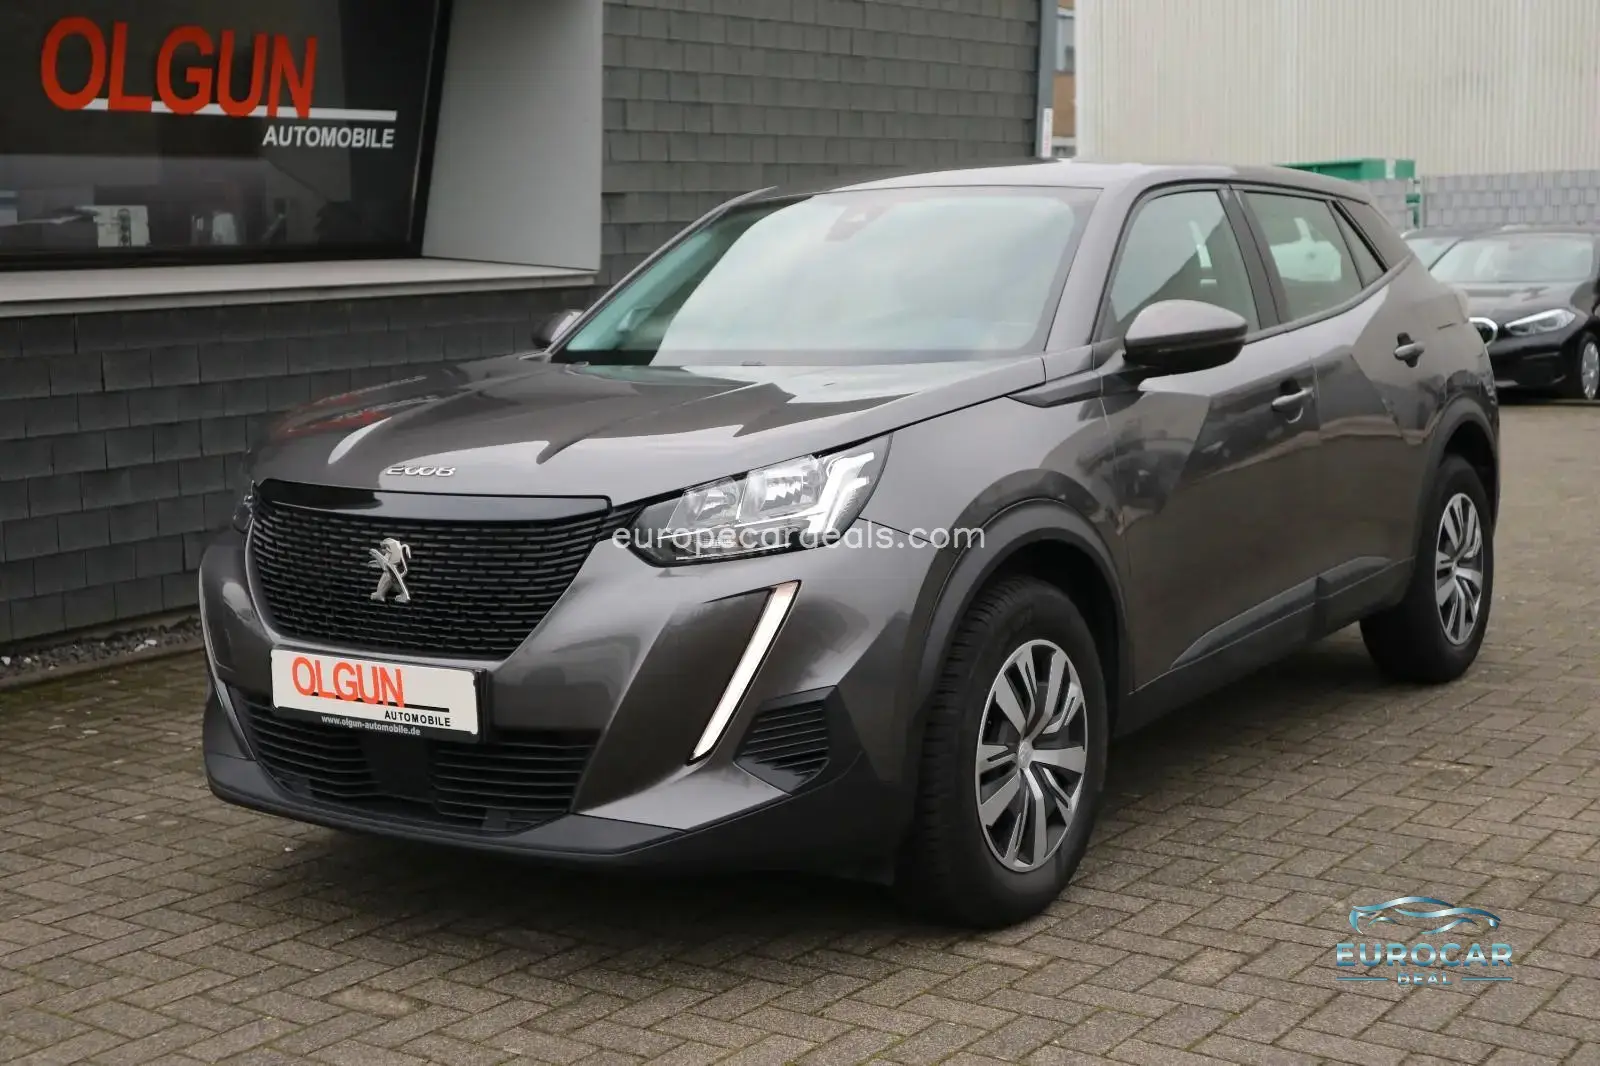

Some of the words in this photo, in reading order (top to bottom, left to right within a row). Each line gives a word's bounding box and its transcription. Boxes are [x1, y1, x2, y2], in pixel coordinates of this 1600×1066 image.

[41, 16, 317, 119] OLGUN
[262, 125, 395, 149] AUTOMOBILE
[291, 656, 405, 708] OLGUN
[321, 715, 421, 736] www.olgun-automobile.de
[384, 710, 451, 727] AUTOMOBILE
